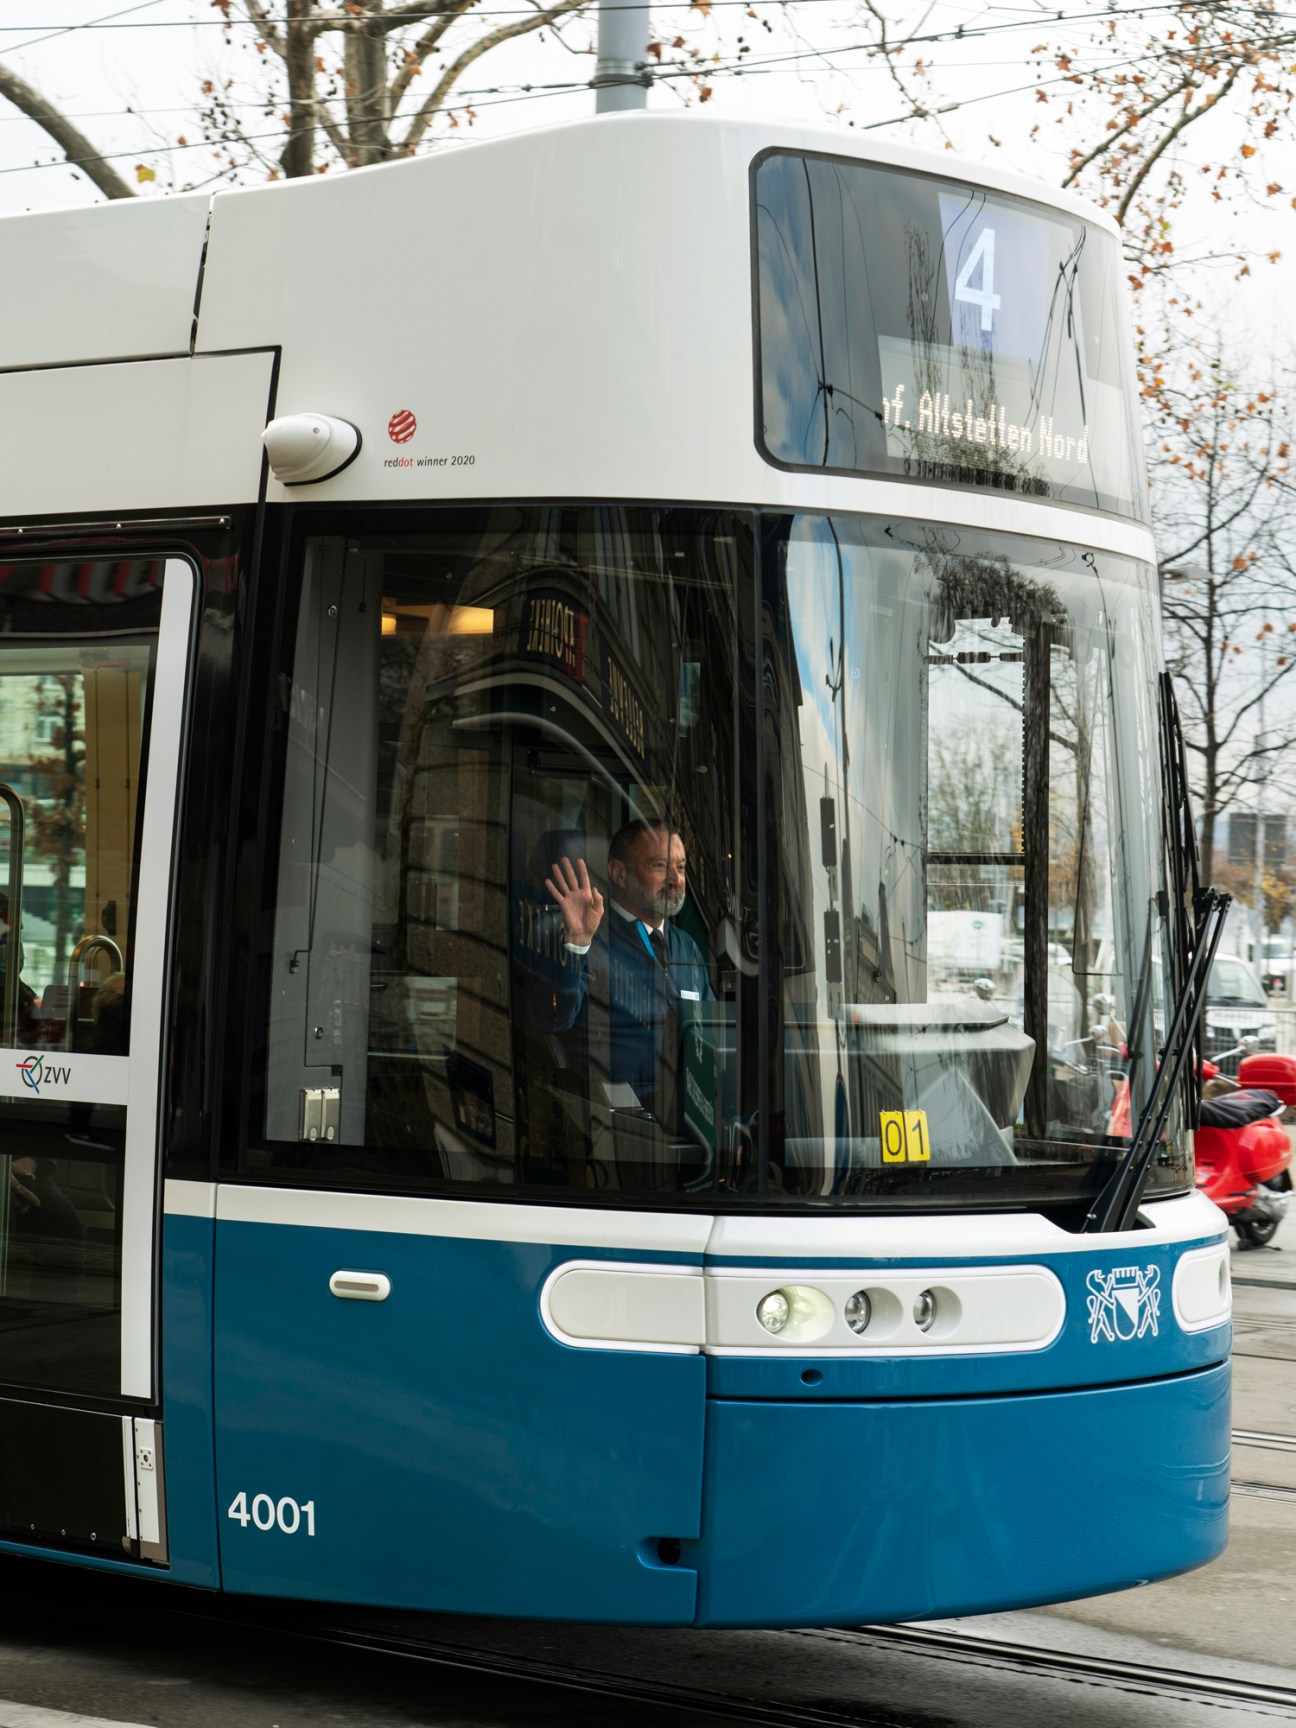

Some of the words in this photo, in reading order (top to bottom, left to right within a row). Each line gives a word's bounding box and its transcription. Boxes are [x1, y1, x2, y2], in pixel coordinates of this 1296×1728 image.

[955, 227, 1001, 332] 4
[918, 389, 1033, 453] Altstetten
[1039, 415, 1089, 464] Nord
[416, 456, 448, 467] winner
[450, 455, 476, 466] 2020
[44, 1066, 71, 1085] ZVV
[885, 1119, 925, 1156] 01
[228, 1491, 315, 1536] 4001
